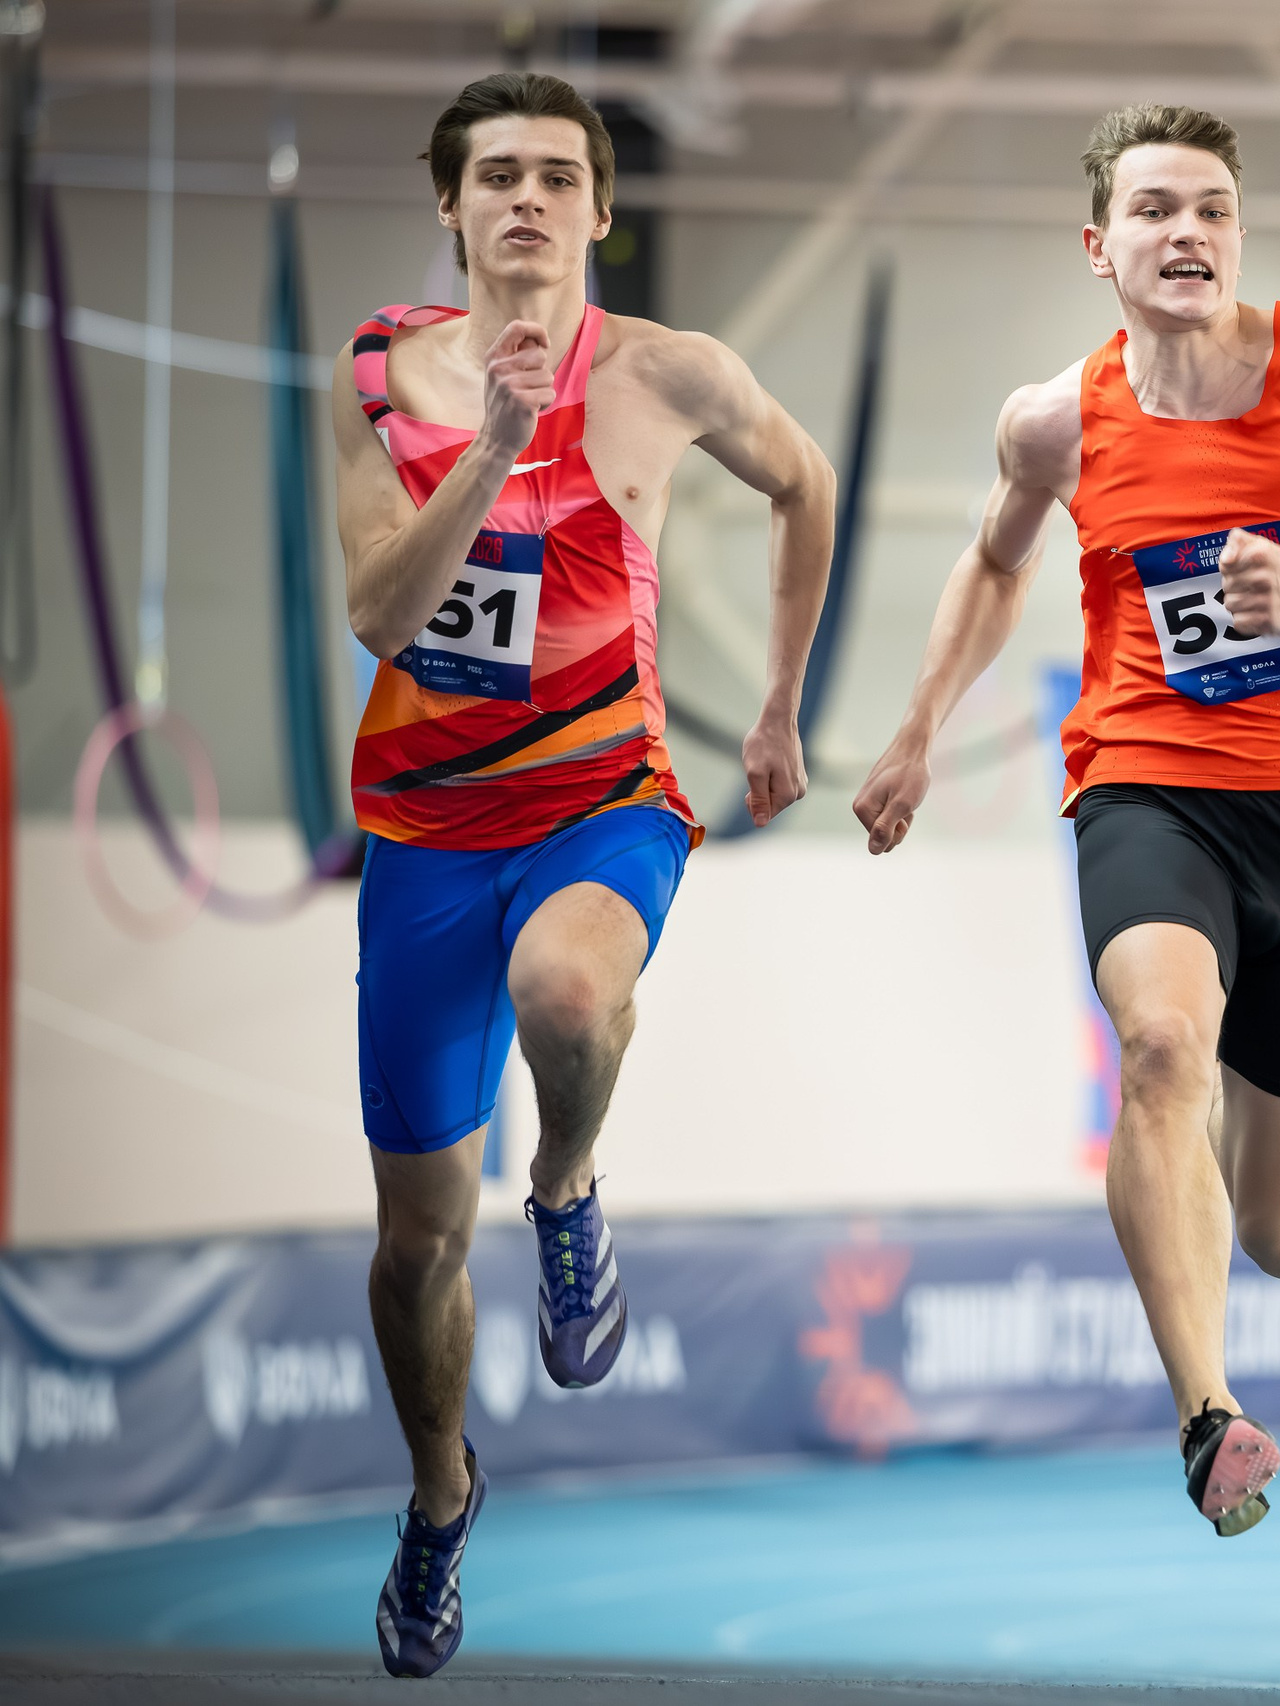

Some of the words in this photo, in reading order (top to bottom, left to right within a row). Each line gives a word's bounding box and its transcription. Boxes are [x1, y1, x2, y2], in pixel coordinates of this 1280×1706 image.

[467, 535, 504, 564] 026
[1200, 555, 1220, 568] ЧЕМП
[425, 579, 517, 648] 51
[432, 659, 457, 669] ВФЛА
[1252, 660, 1276, 671] ВФЛА
